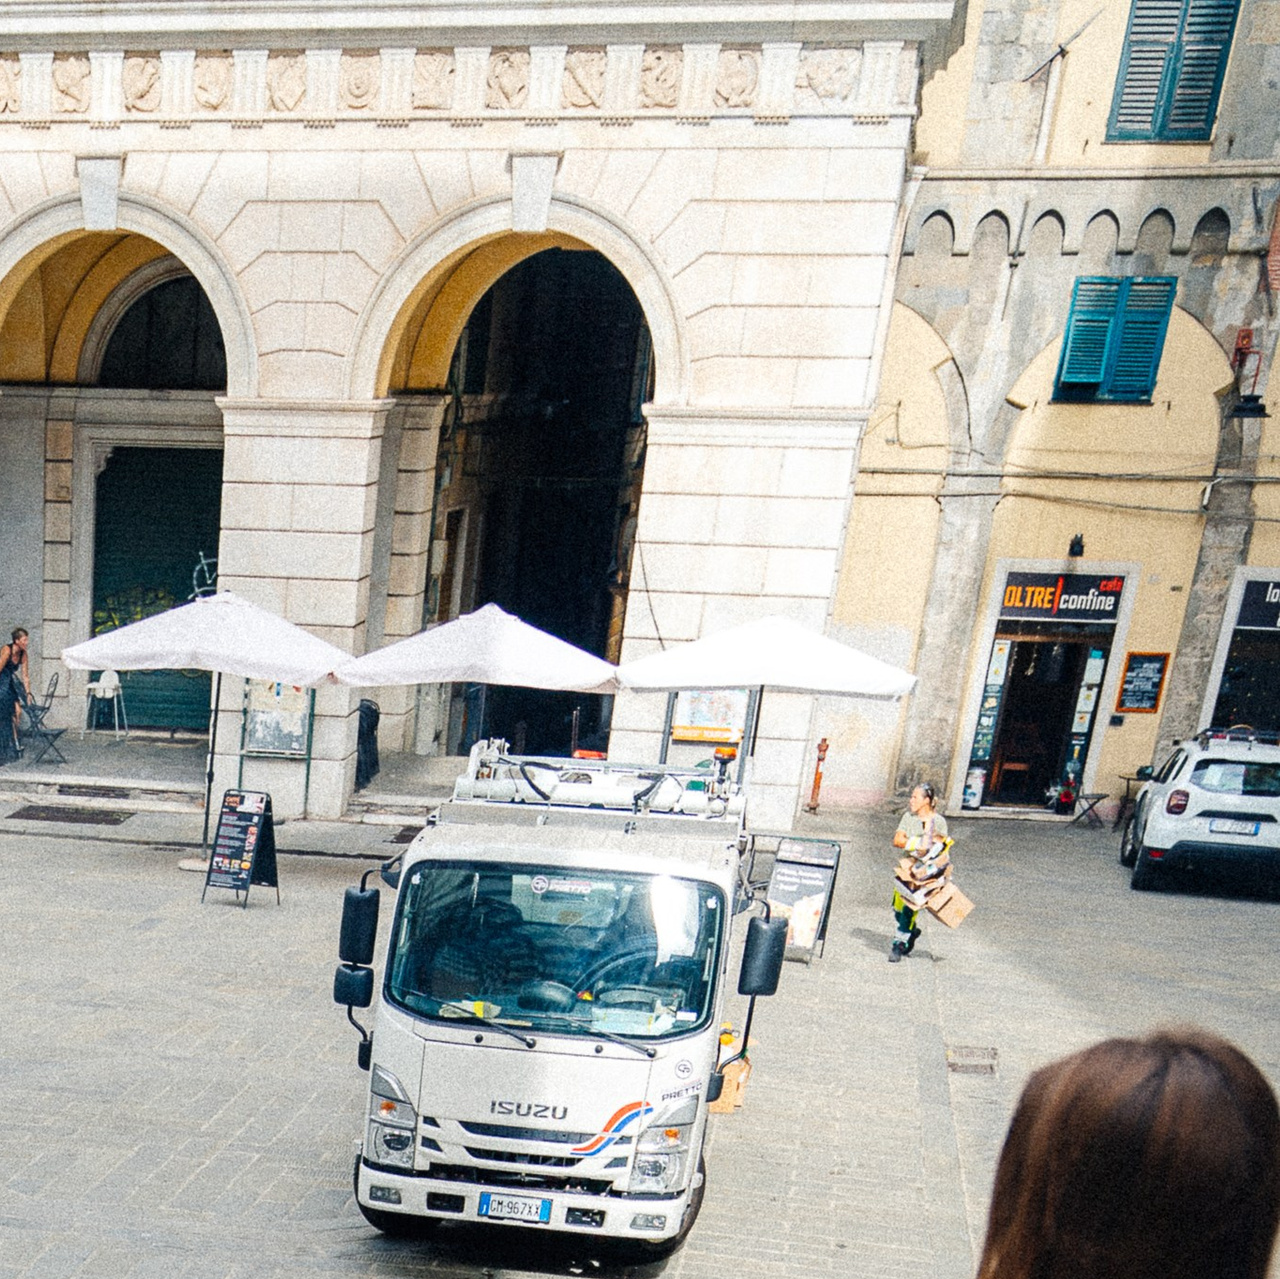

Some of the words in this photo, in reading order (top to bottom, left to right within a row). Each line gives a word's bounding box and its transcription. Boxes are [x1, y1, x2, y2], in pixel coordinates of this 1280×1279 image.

[1003, 585, 1055, 608] OLTRE
[1060, 588, 1115, 610] confine
[1266, 583, 1280, 602] lo
[661, 1082, 702, 1101] PRETTO
[490, 1099, 568, 1120] ISUZU
